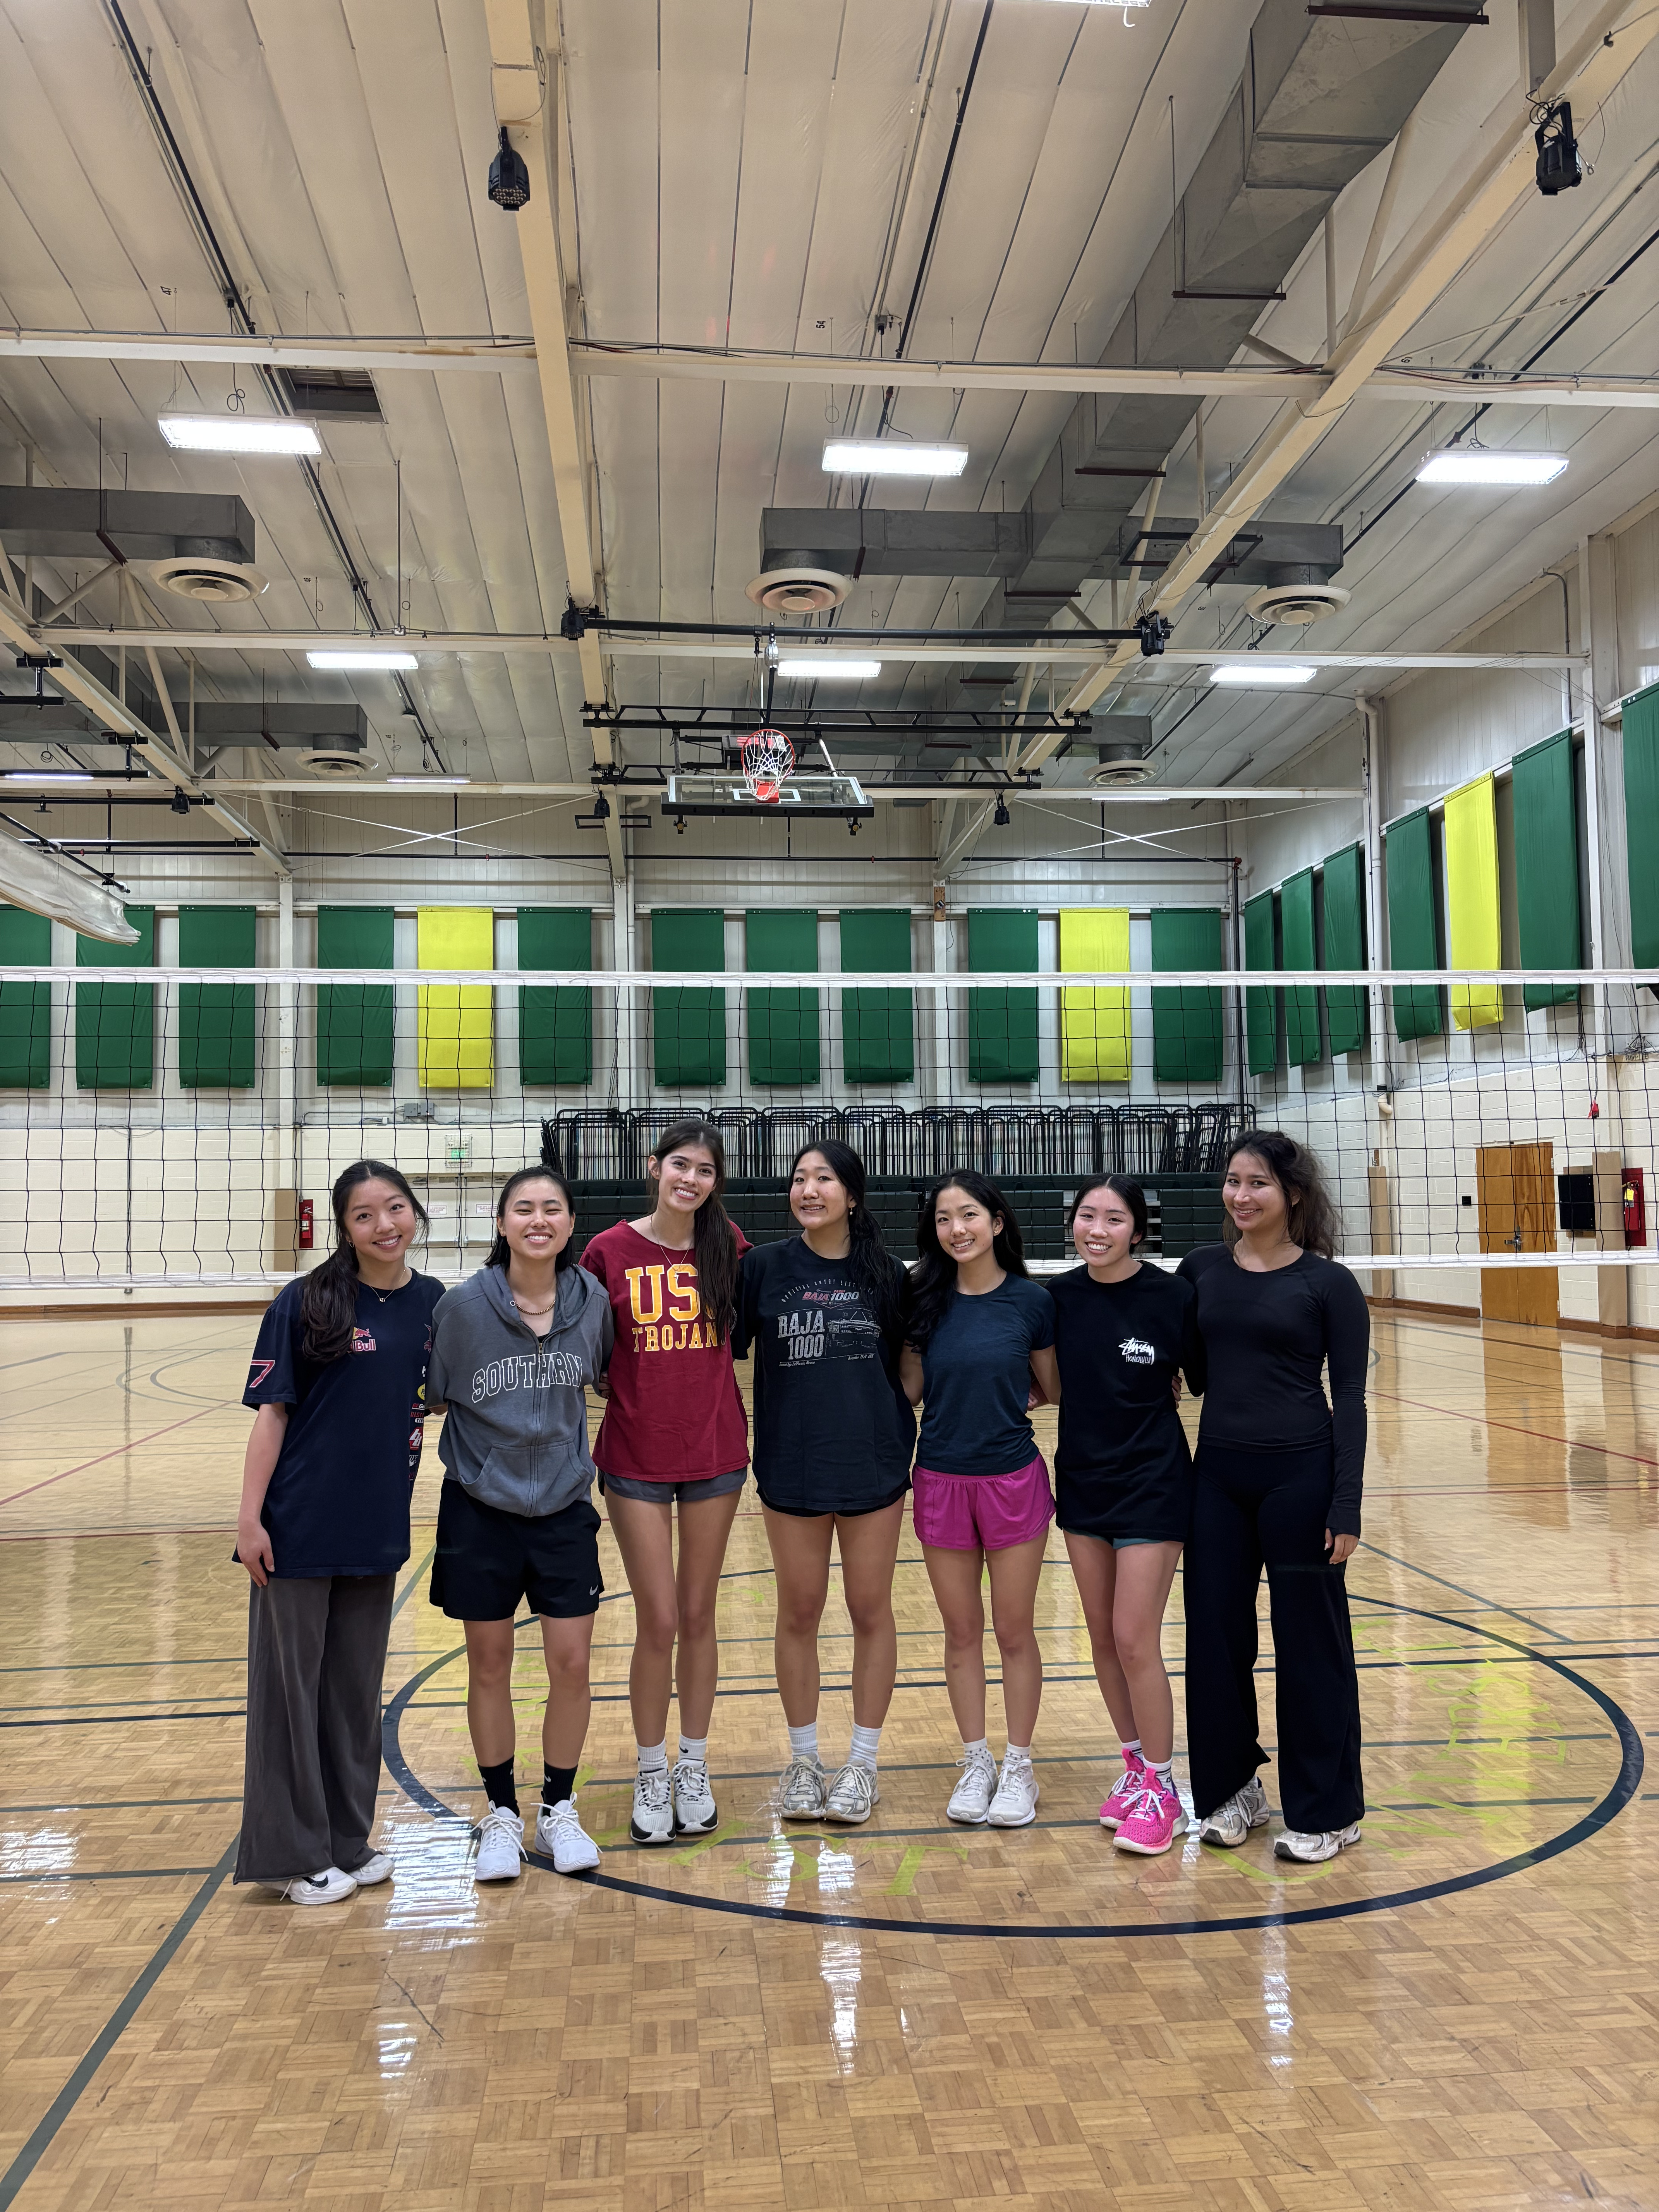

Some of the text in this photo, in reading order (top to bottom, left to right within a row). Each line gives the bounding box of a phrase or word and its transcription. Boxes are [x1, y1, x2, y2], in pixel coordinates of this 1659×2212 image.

[160, 286, 172, 295] 47
[625, 1263, 715, 1324] US
[802, 1291, 860, 1301] BAJA 1000
[778, 1310, 824, 1338] BAJA
[355, 1339, 376, 1352] Bull
[632, 1322, 726, 1352] TROJAN
[788, 1334, 824, 1360] 1000
[1126, 1354, 1151, 1364] HONOLULU
